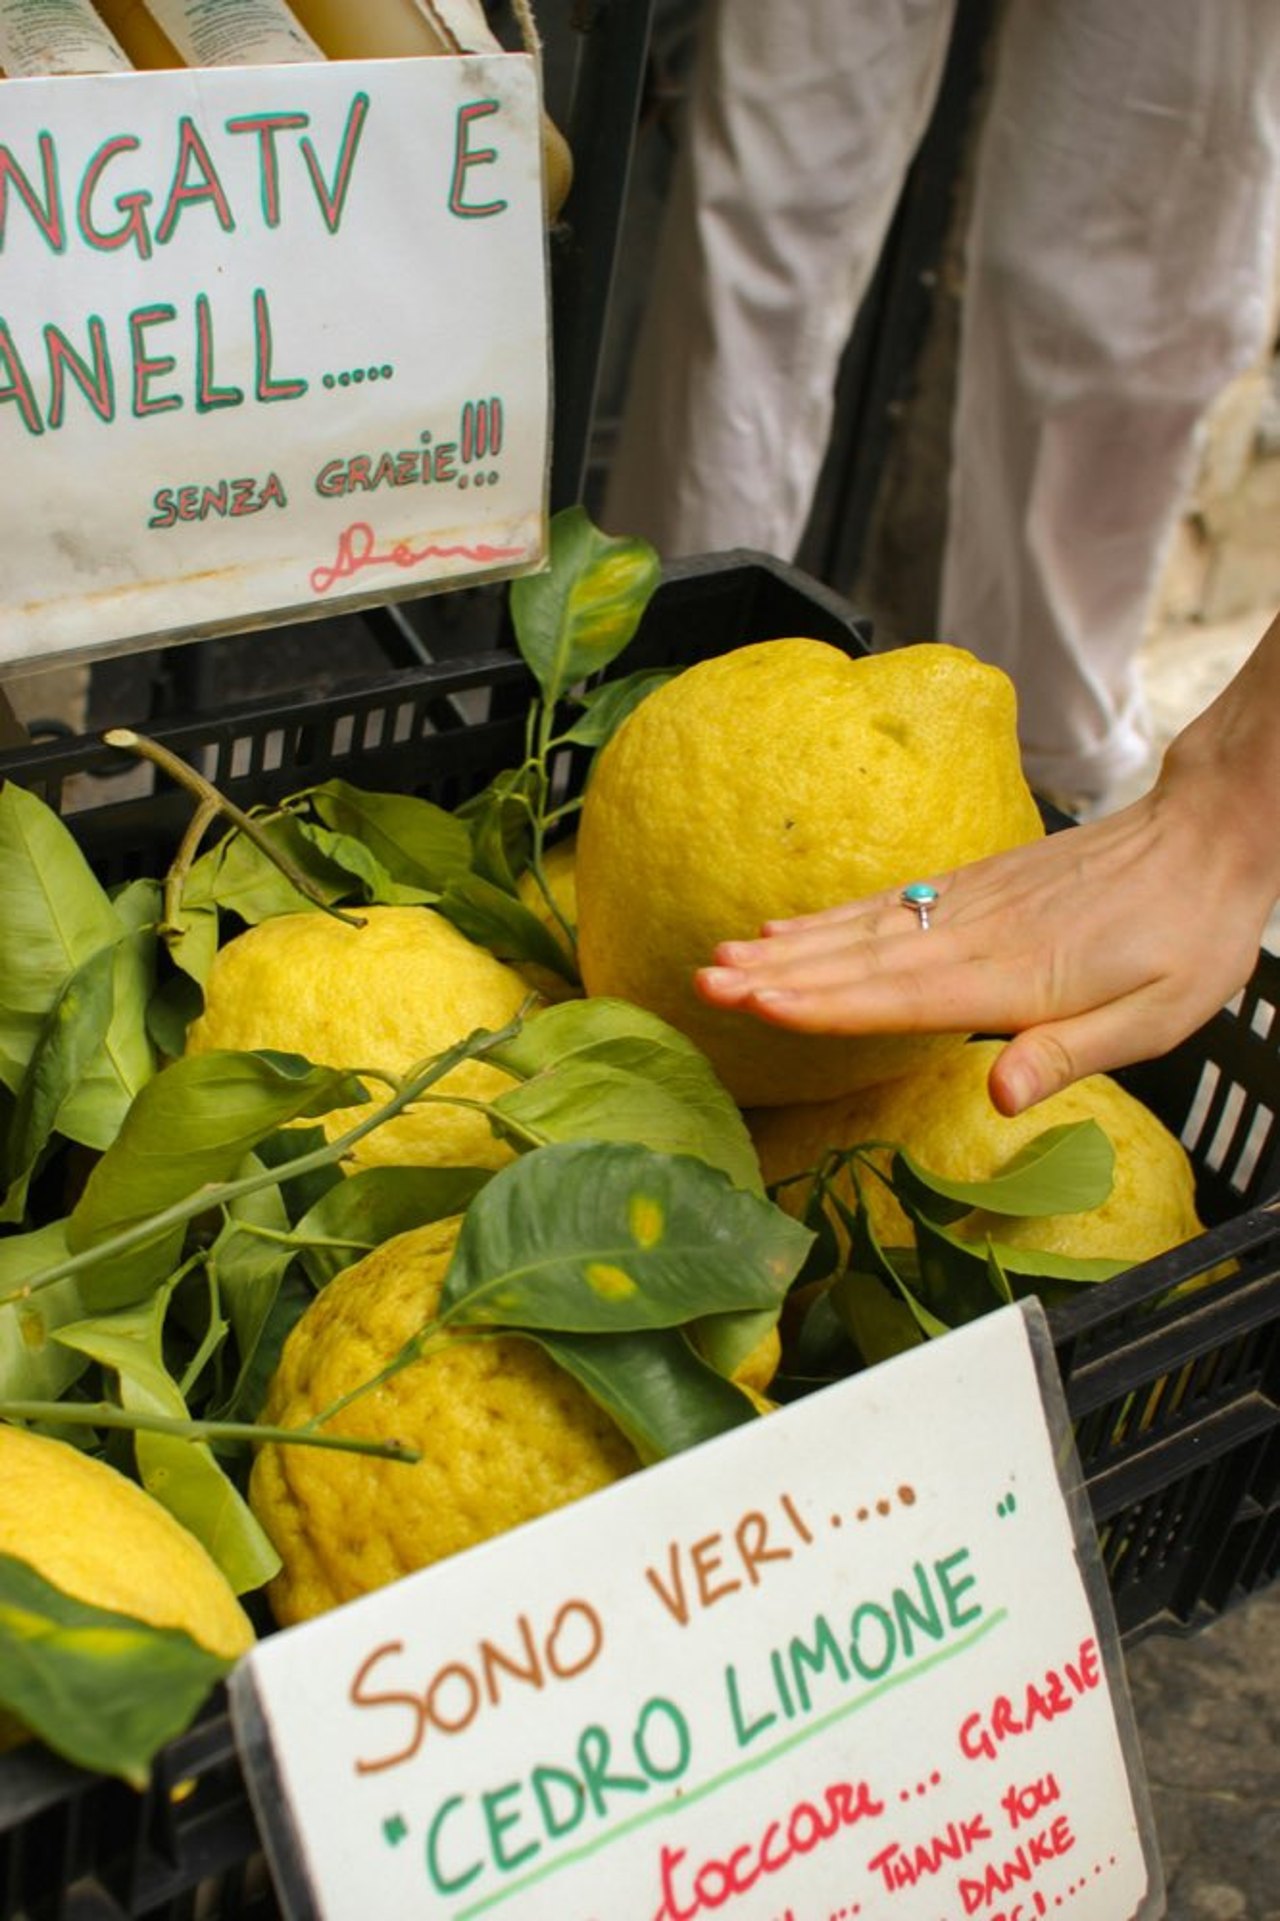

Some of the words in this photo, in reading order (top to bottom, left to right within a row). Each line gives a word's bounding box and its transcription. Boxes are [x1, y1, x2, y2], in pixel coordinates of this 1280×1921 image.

[449, 98, 508, 219] E
[148, 472, 287, 528] SENZA
[349, 1598, 603, 1775] SONO
[959, 1637, 1100, 1760] GRAZIE
[868, 1813, 992, 1893] THANK
[1001, 1772, 1061, 1829] YOU
[958, 1815, 1076, 1915] DANKE
